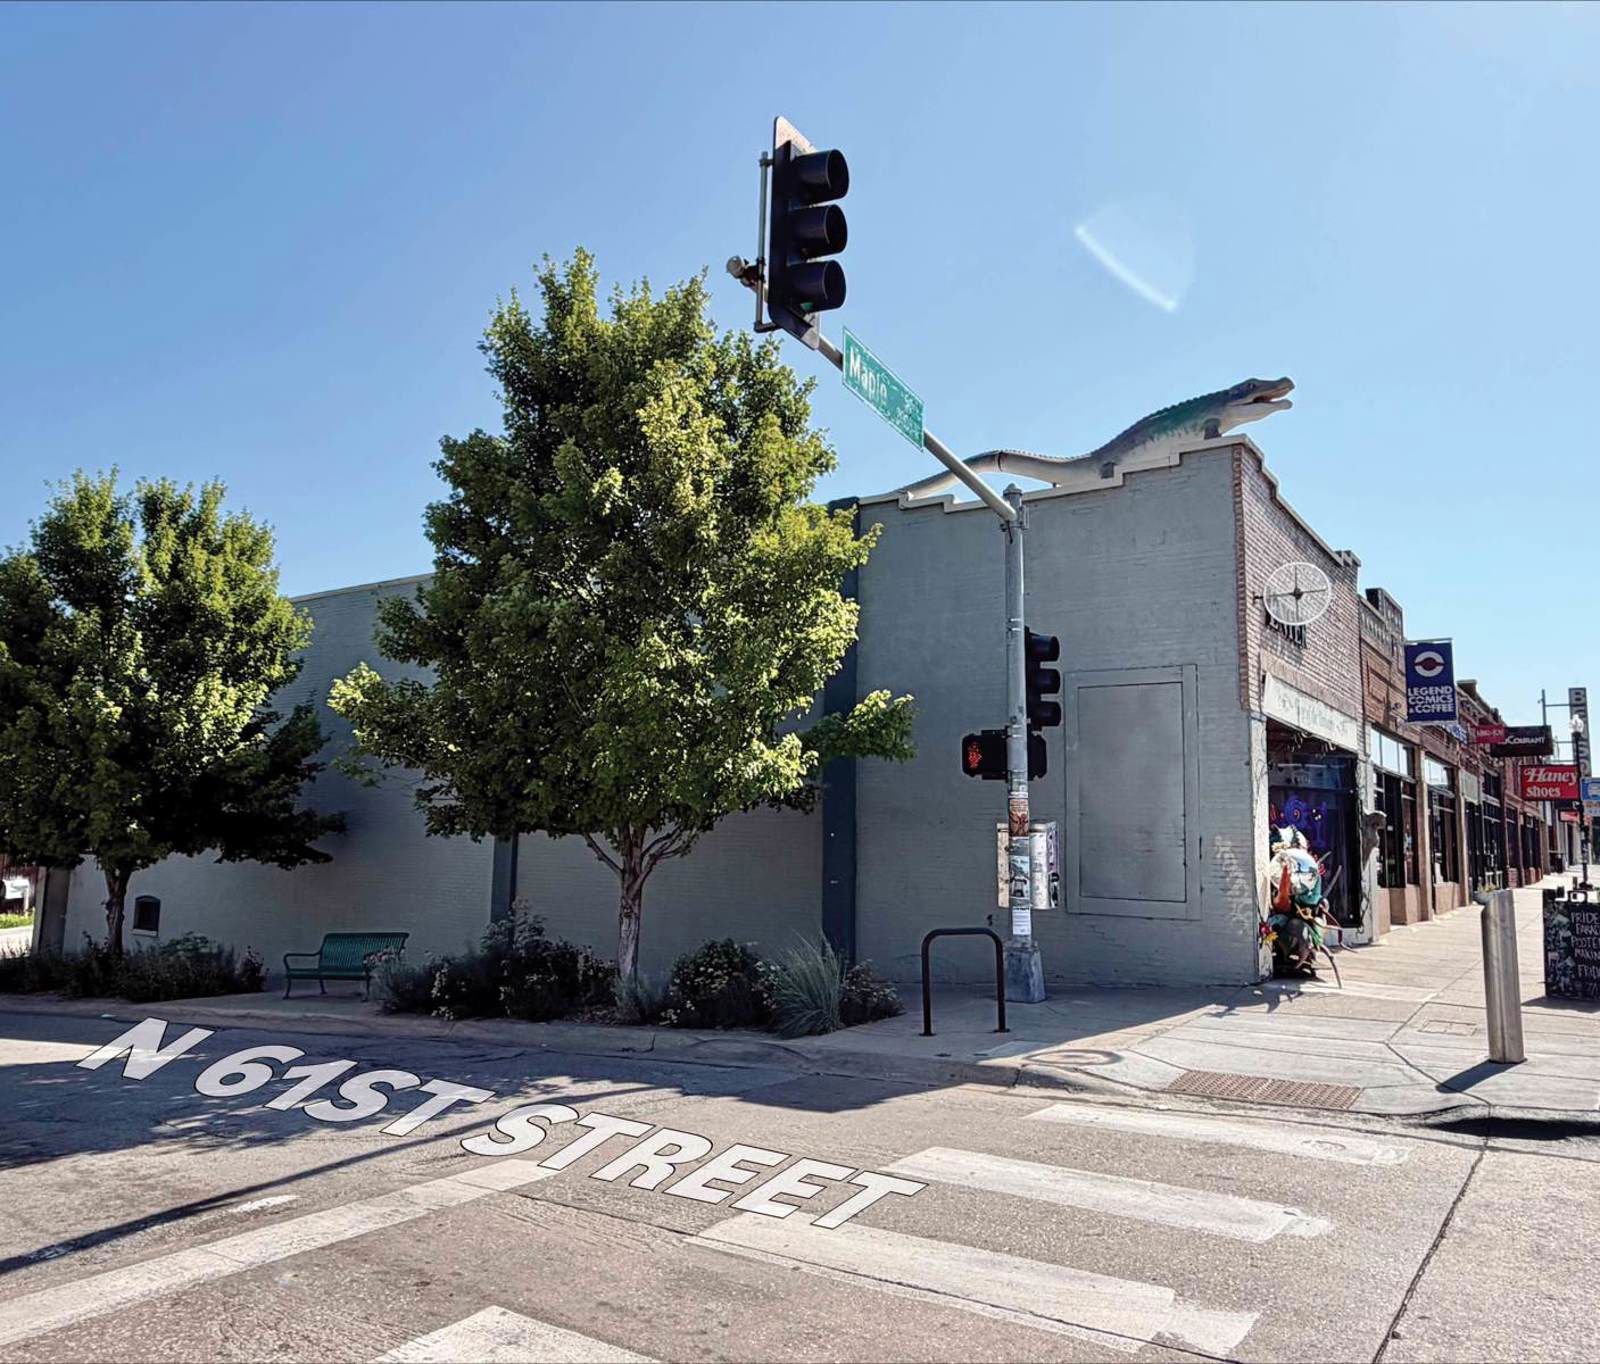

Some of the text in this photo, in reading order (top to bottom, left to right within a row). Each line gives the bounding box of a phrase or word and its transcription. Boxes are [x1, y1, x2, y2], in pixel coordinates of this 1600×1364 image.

[848, 346, 888, 401] Maple
[1407, 685, 1453, 697] LEGEND
[1408, 694, 1454, 705] COMICS
[1415, 703, 1454, 714] COFFEE
[1523, 768, 1578, 786] Haney
[1526, 786, 1561, 798] shoes
